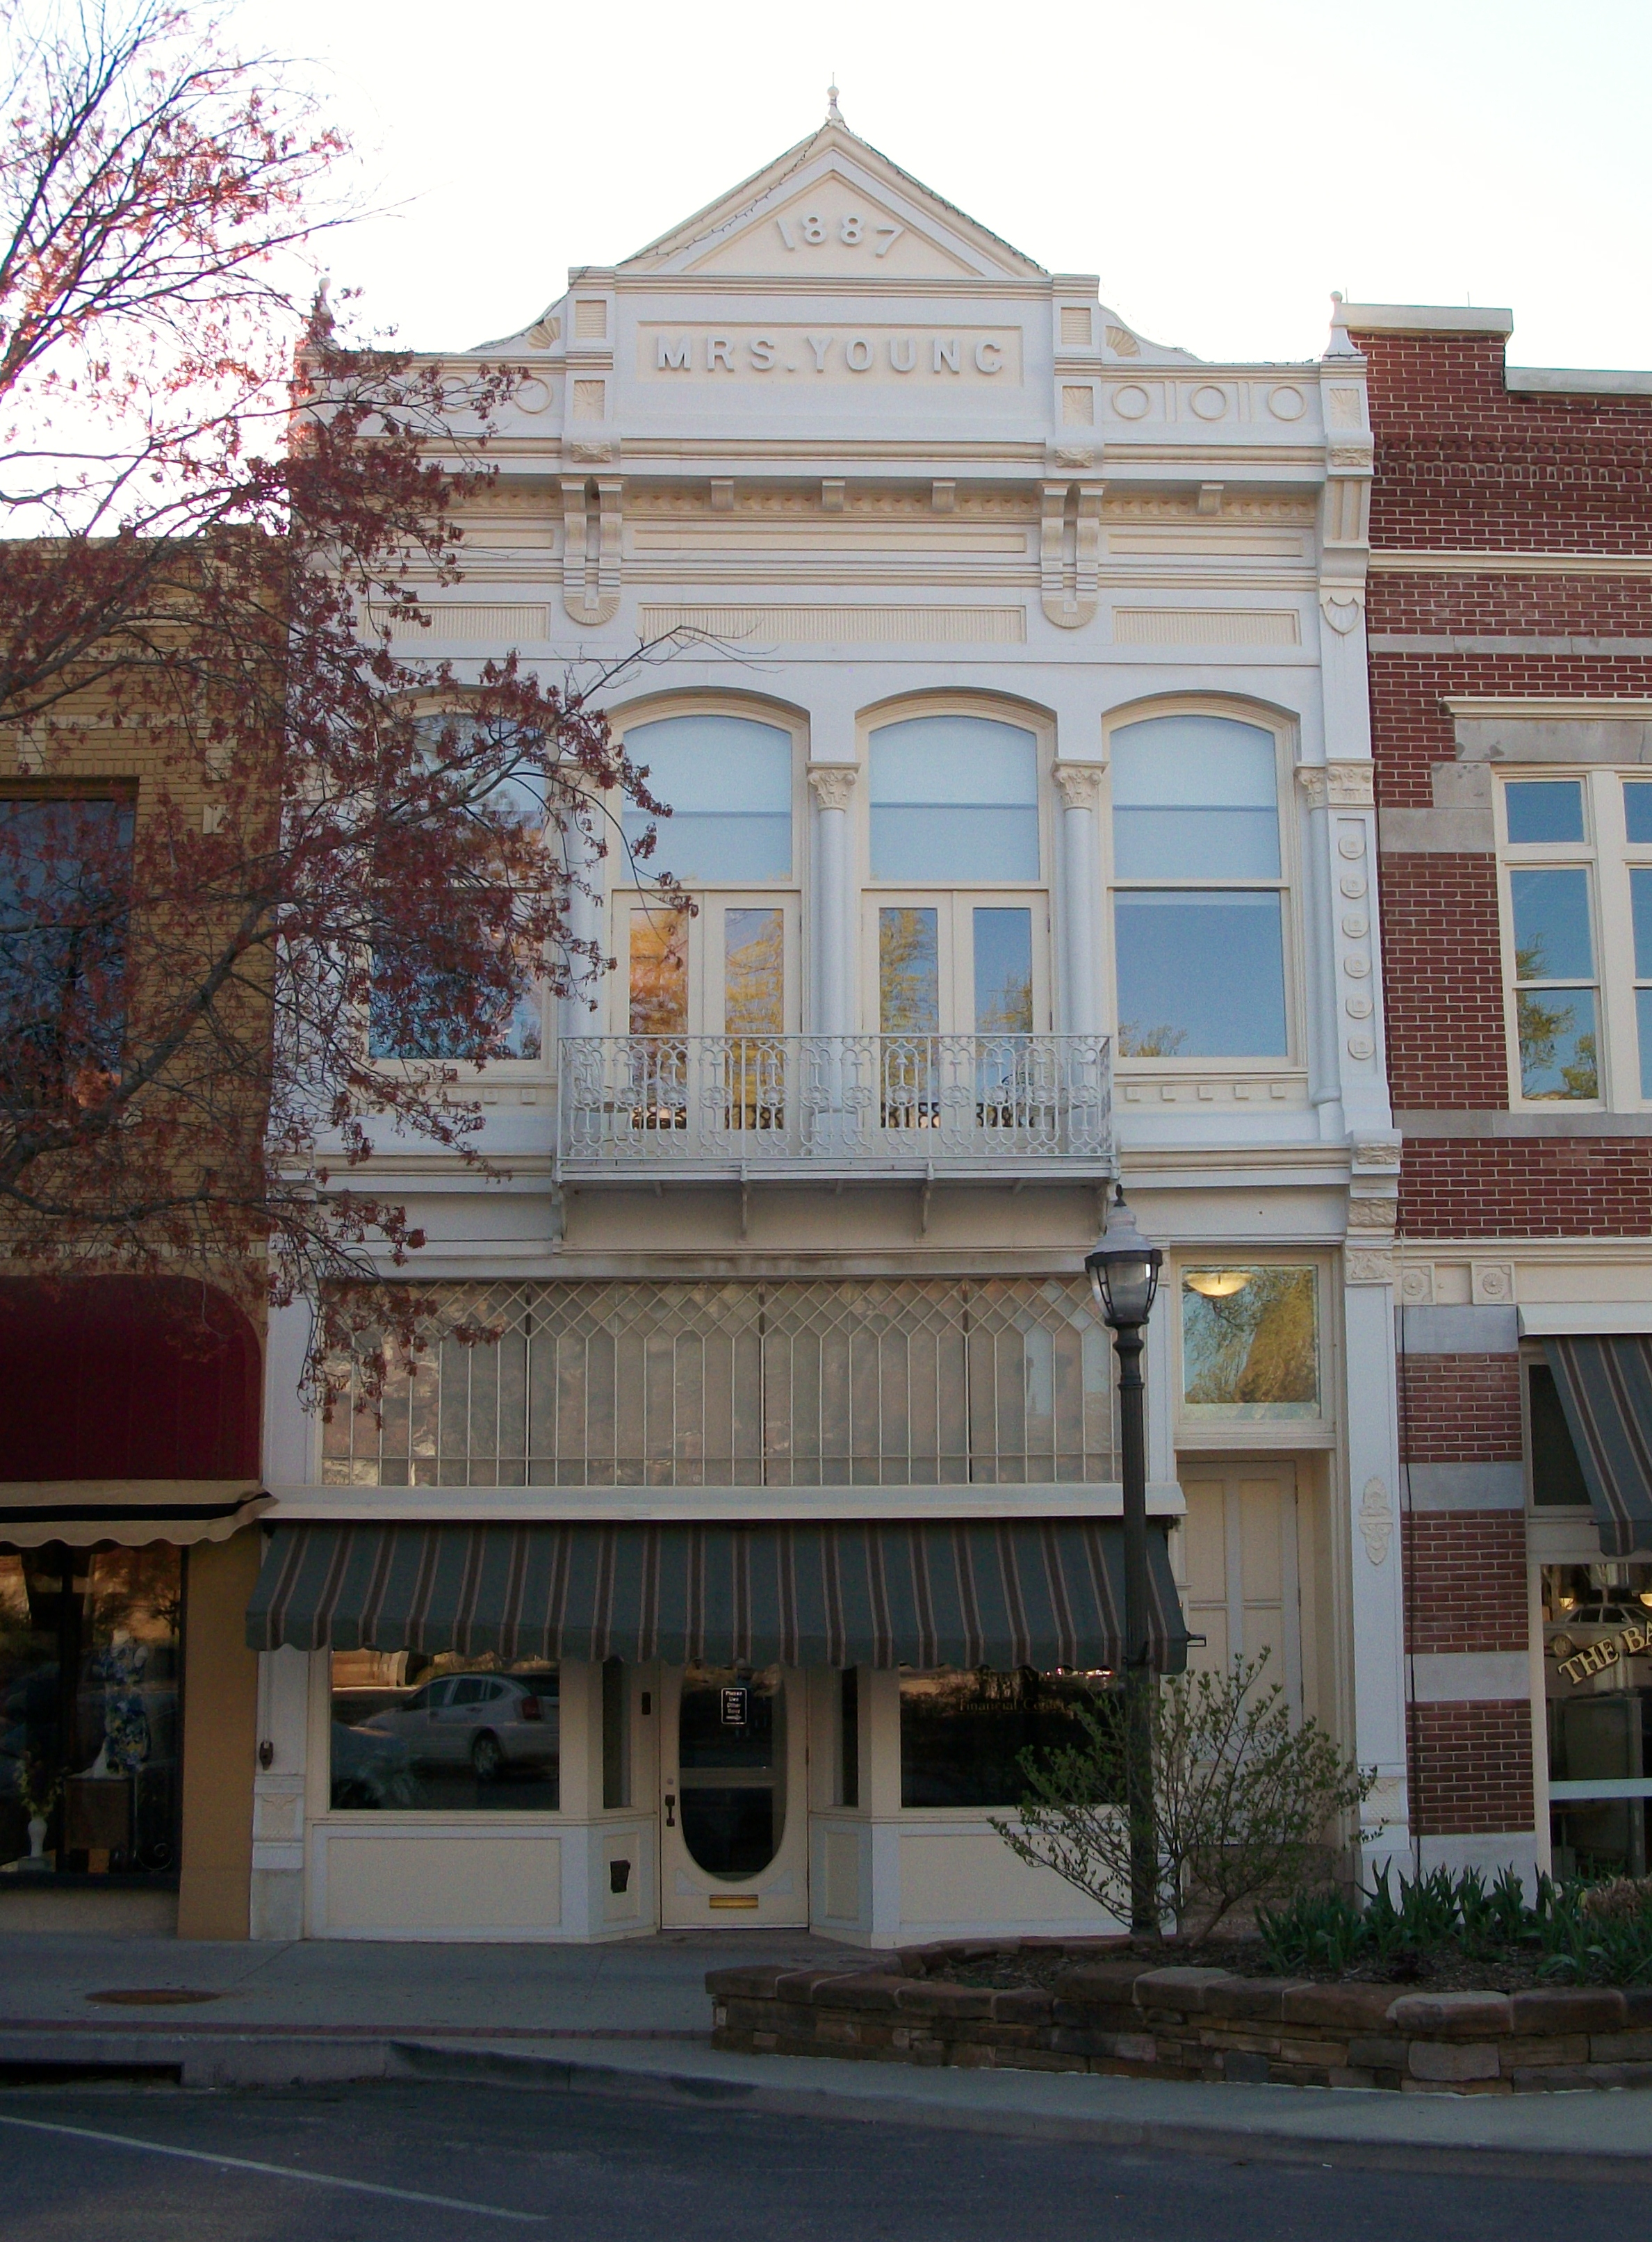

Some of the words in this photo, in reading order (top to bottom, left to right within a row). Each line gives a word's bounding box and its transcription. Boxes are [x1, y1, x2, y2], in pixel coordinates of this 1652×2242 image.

[776, 212, 906, 258] 1887
[807, 336, 1003, 375] YOUNG
[1557, 1638, 1620, 1685] THE
